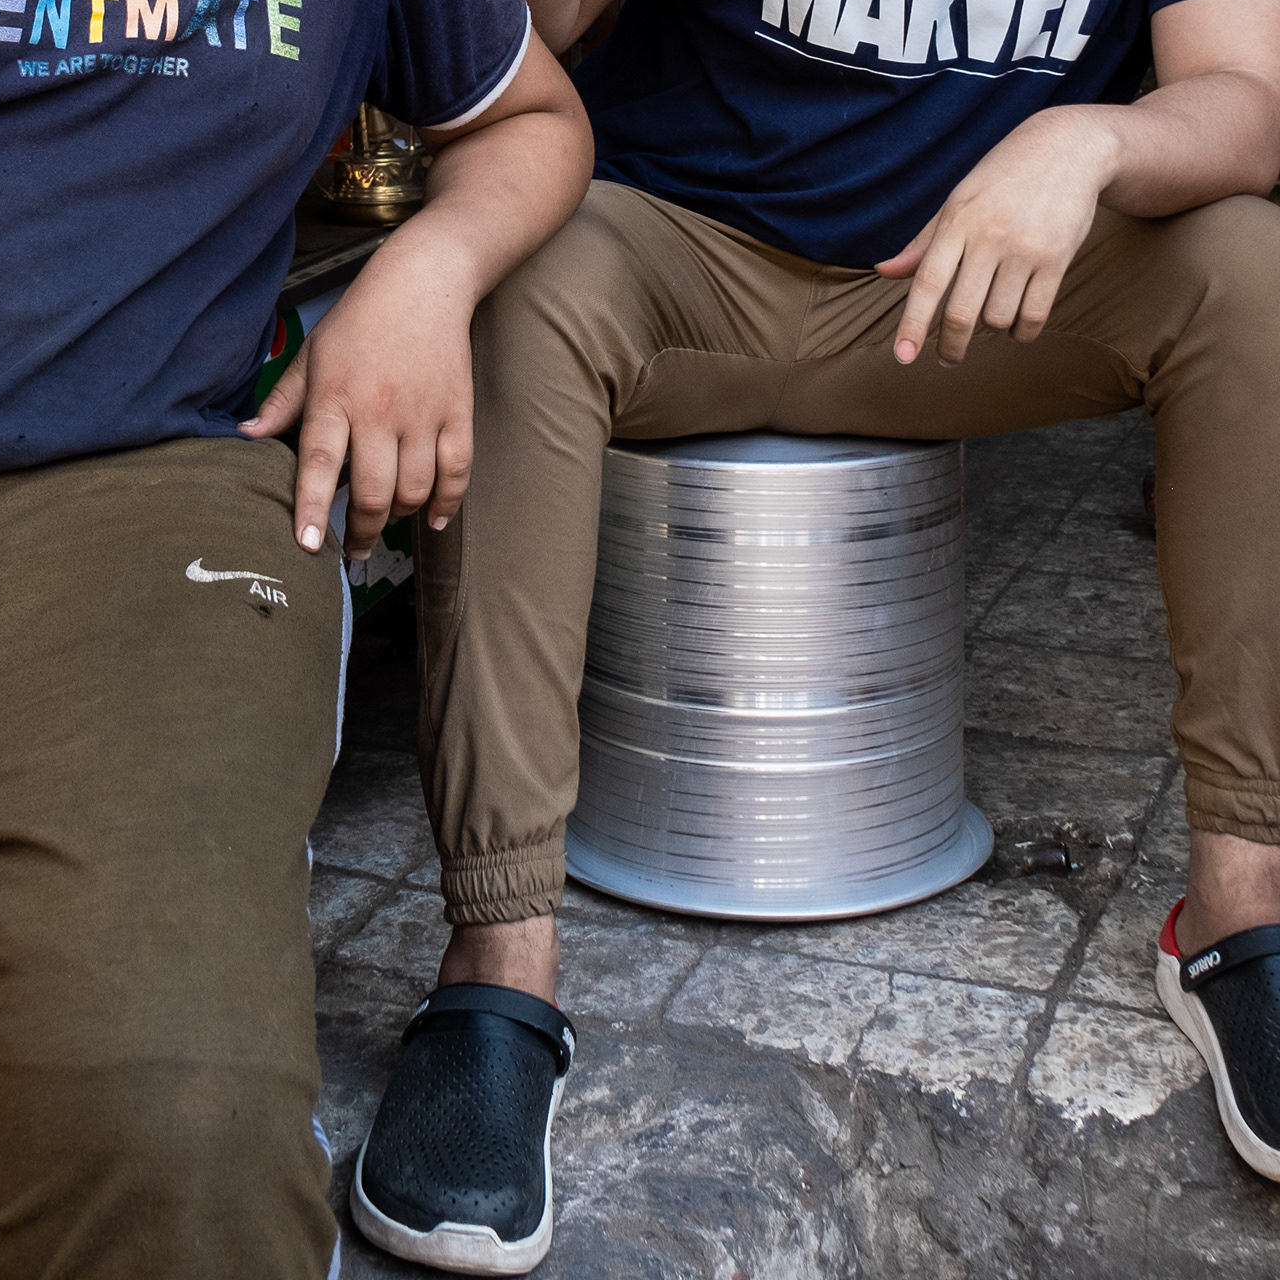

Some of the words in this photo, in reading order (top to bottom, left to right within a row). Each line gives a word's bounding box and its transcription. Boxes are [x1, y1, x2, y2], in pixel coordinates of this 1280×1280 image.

[17, 59, 50, 77] WE
[54, 54, 96, 75] ARE
[249, 580, 289, 607] AIR
